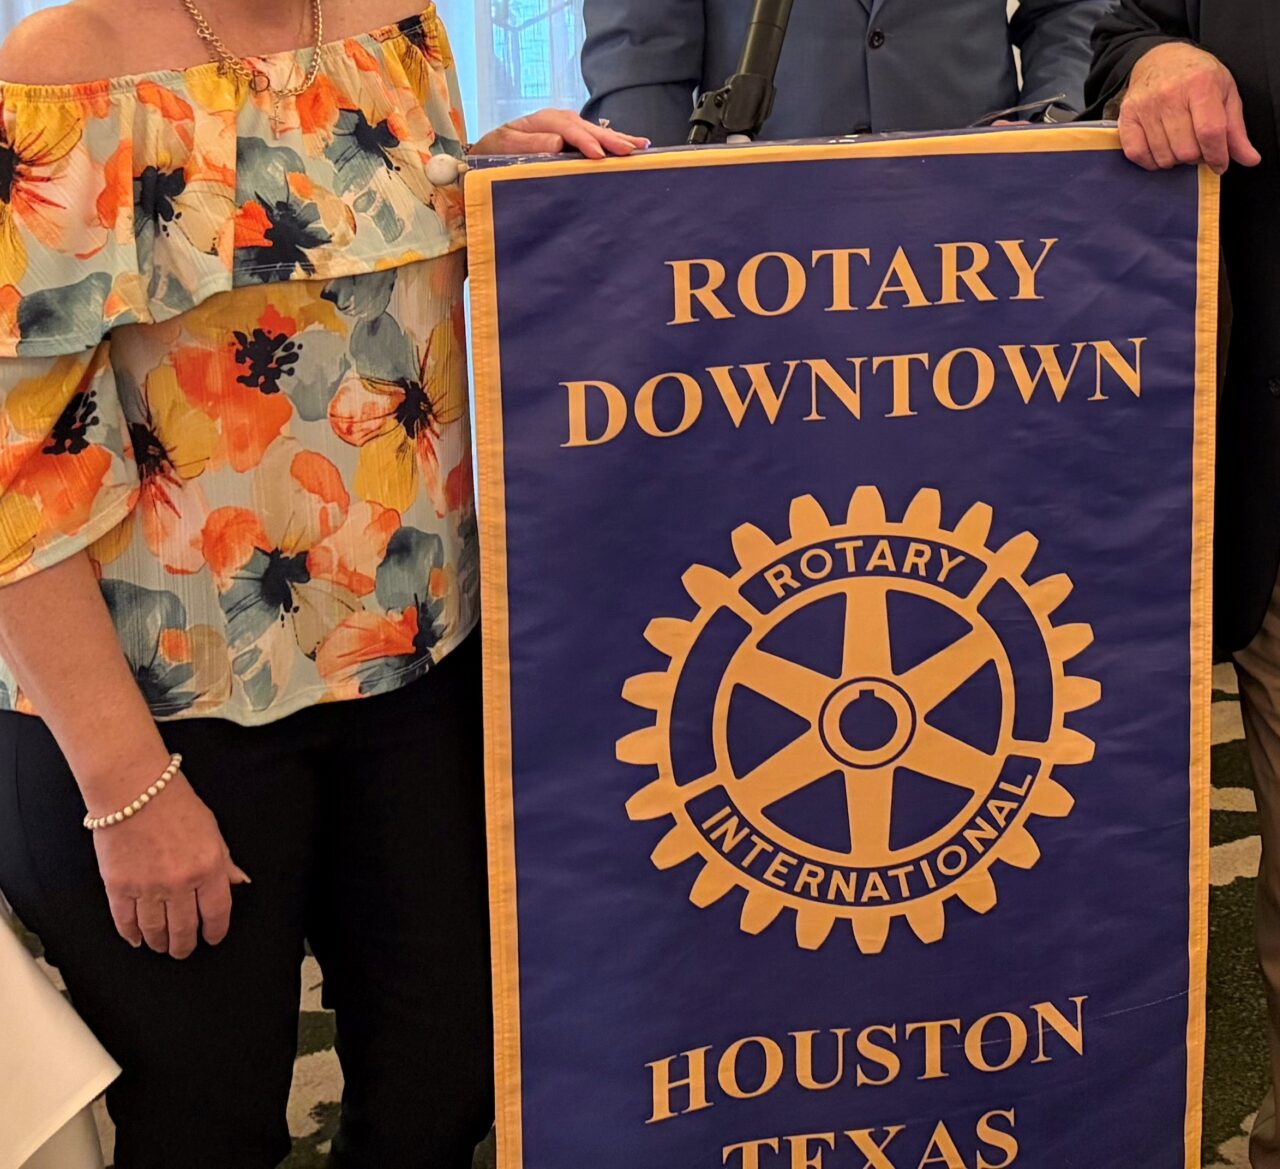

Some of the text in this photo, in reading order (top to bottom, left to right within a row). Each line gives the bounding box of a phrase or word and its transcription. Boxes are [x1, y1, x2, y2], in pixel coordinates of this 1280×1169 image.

[665, 237, 1058, 325] ROTARY
[559, 337, 1147, 448] DOWNTOWN
[763, 538, 966, 599] ROTARY
[701, 774, 1034, 904] INTERNATIONAL
[644, 995, 1088, 1123] HOUSTON
